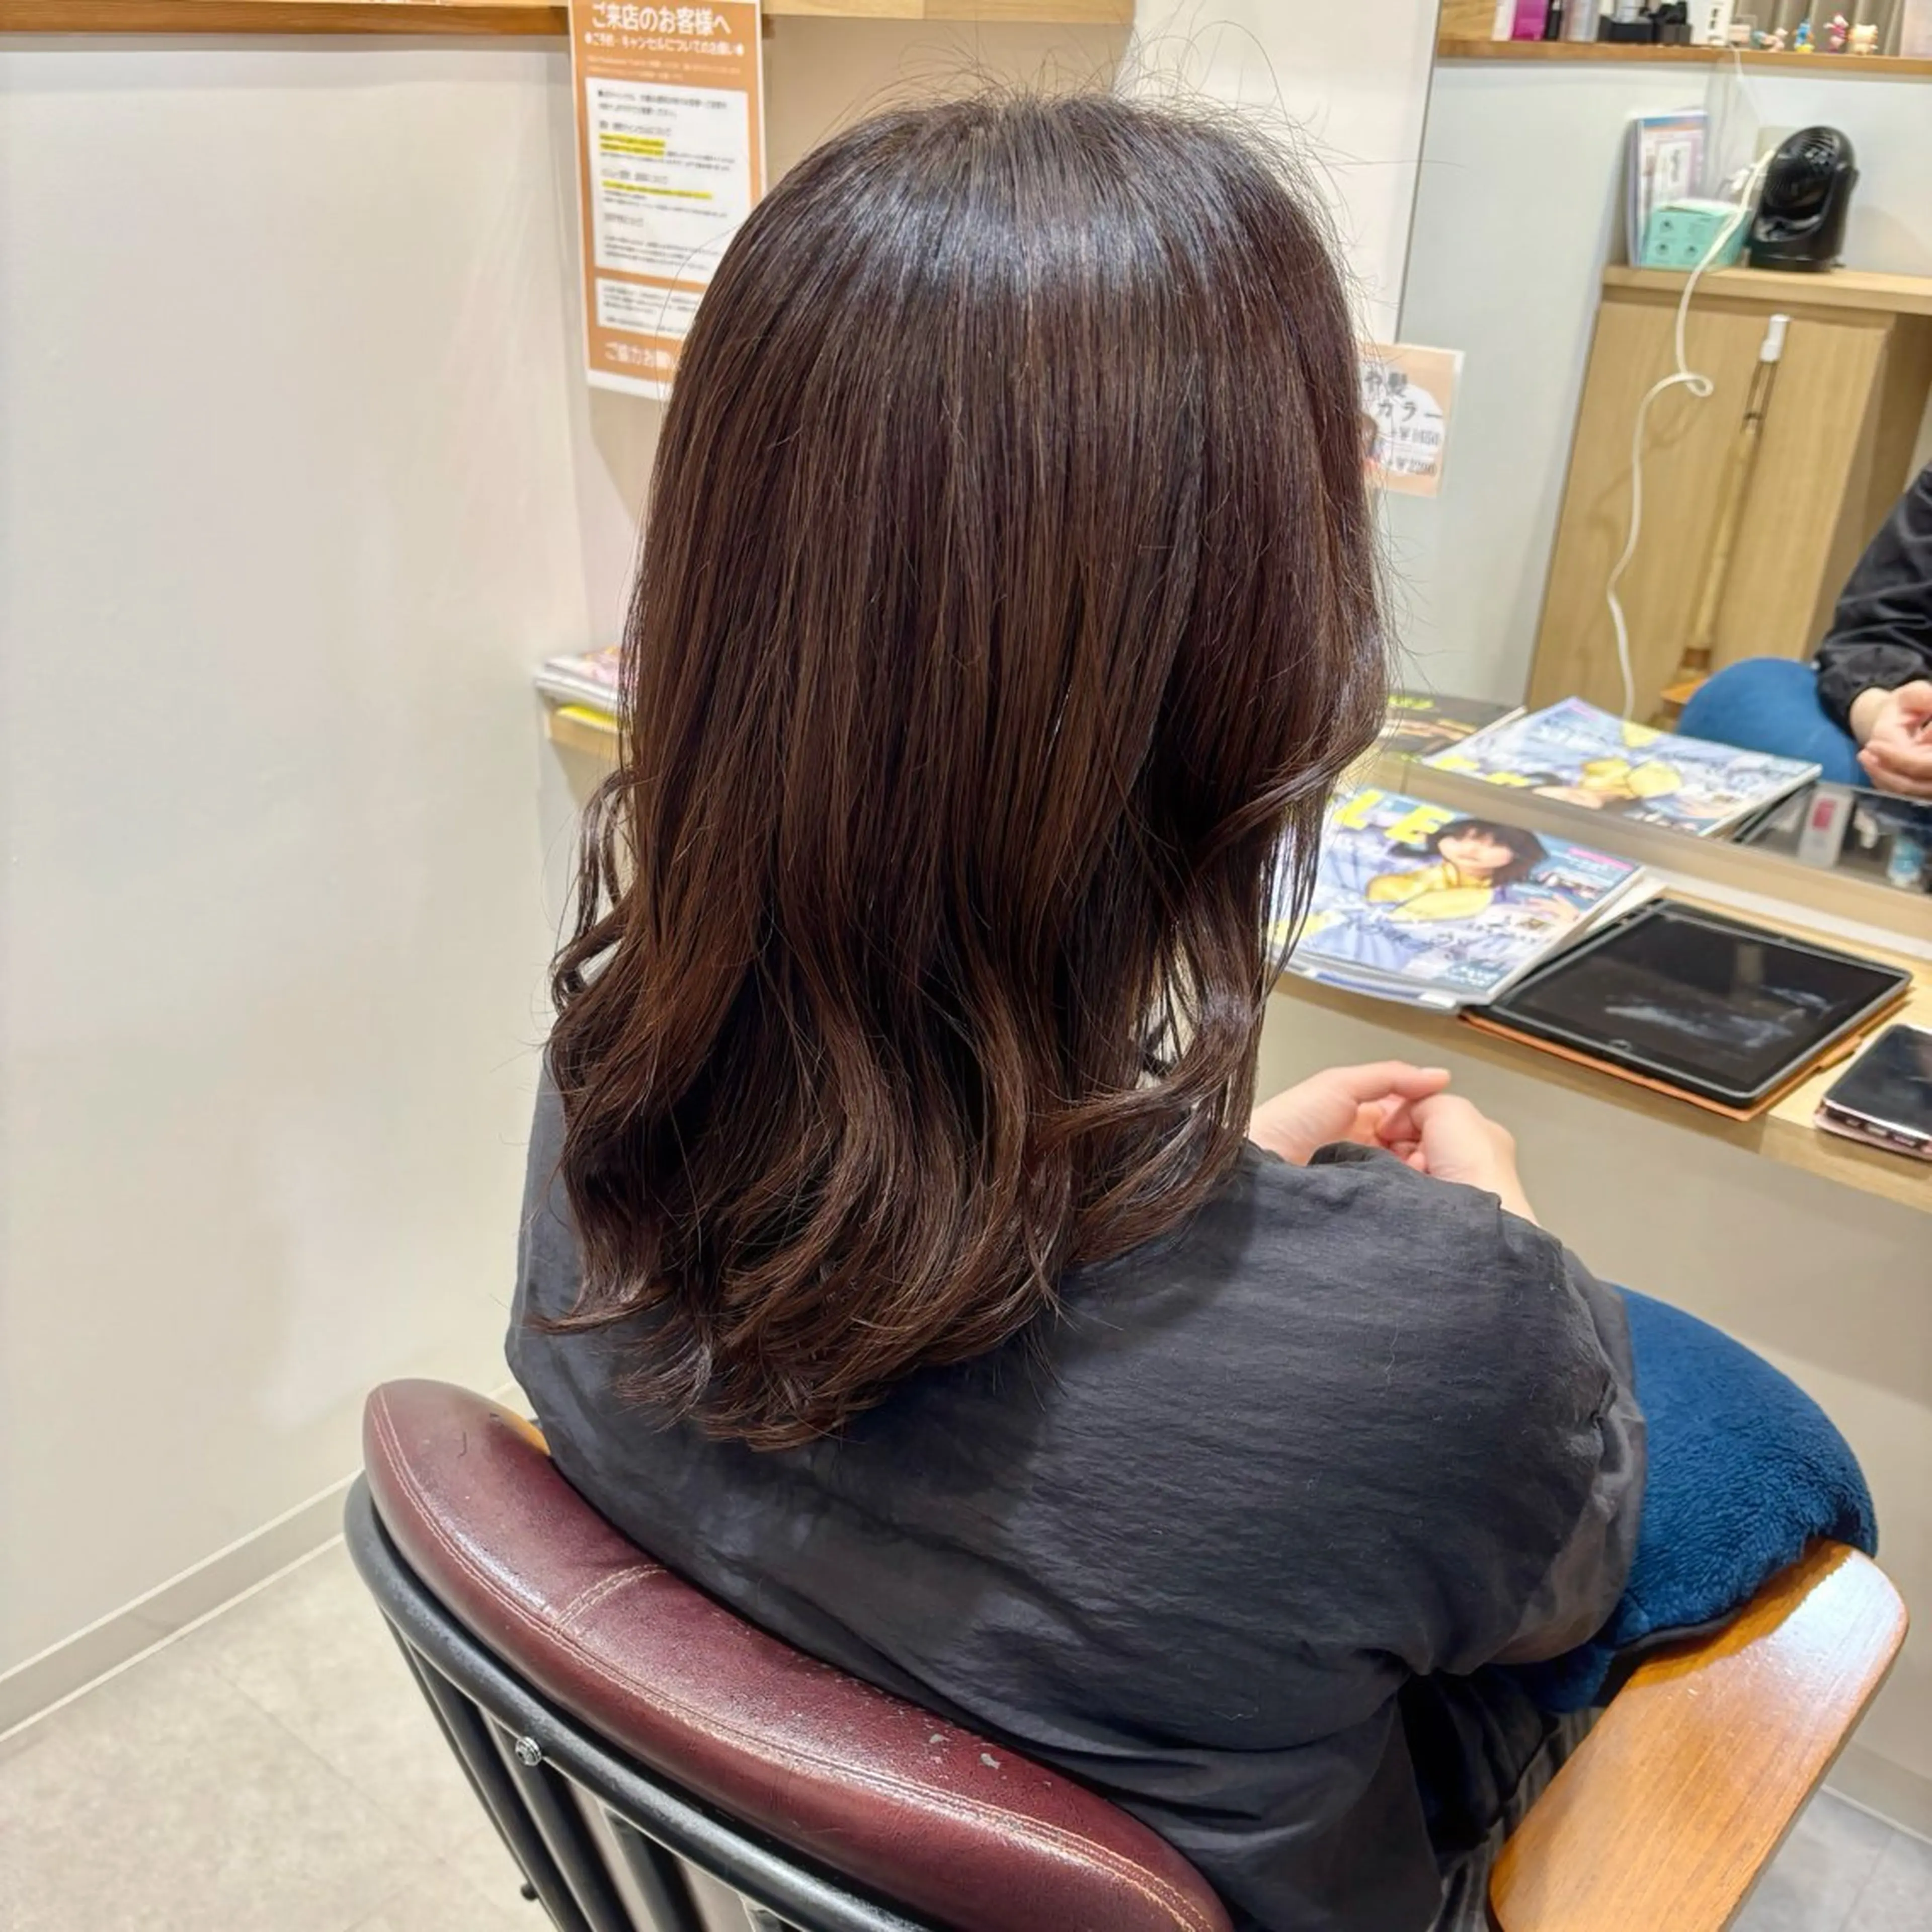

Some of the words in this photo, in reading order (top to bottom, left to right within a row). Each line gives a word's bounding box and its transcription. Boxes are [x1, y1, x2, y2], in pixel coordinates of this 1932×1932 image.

[592, 3, 732, 36] ご来店のお客様へ
